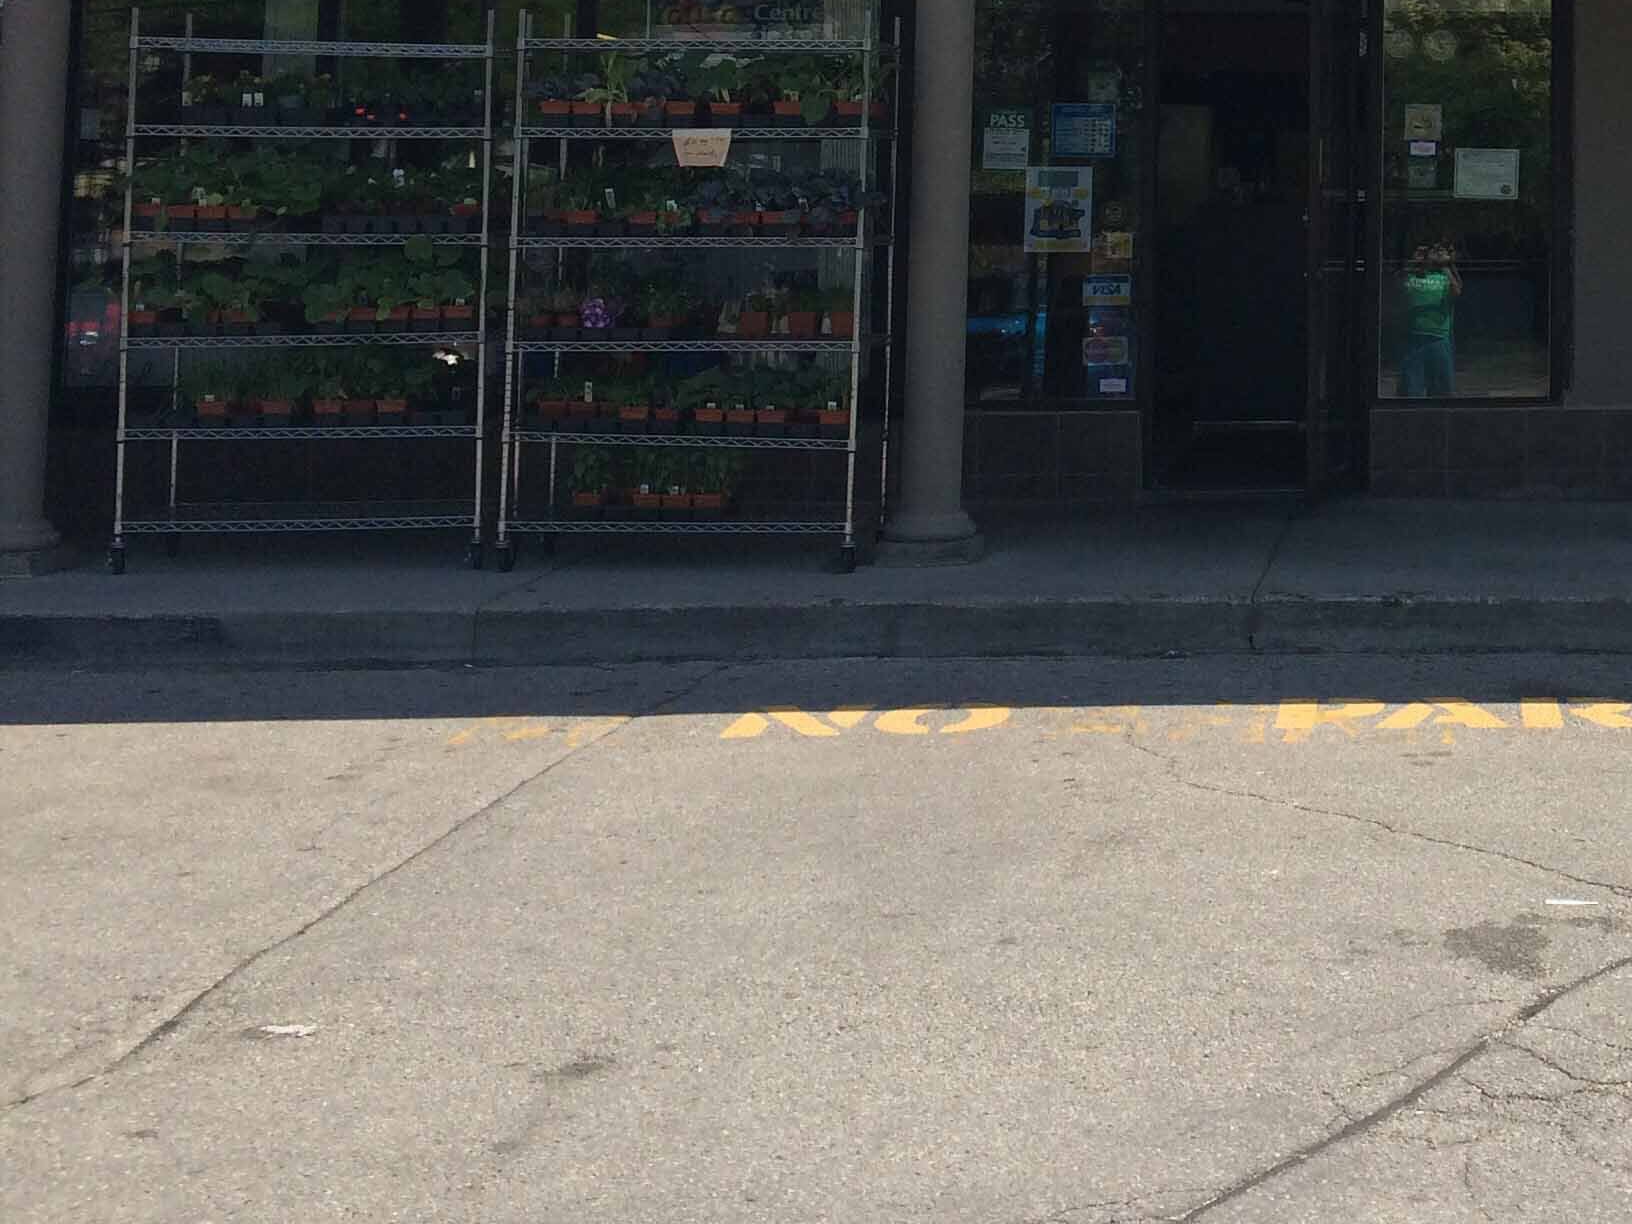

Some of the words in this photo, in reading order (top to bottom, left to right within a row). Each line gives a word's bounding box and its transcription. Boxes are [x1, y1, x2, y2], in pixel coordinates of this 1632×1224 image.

[754, 5, 822, 21] Centre
[989, 114, 1025, 127] PASS
[1092, 283, 1122, 295] VISA
[719, 704, 1011, 738] NO
